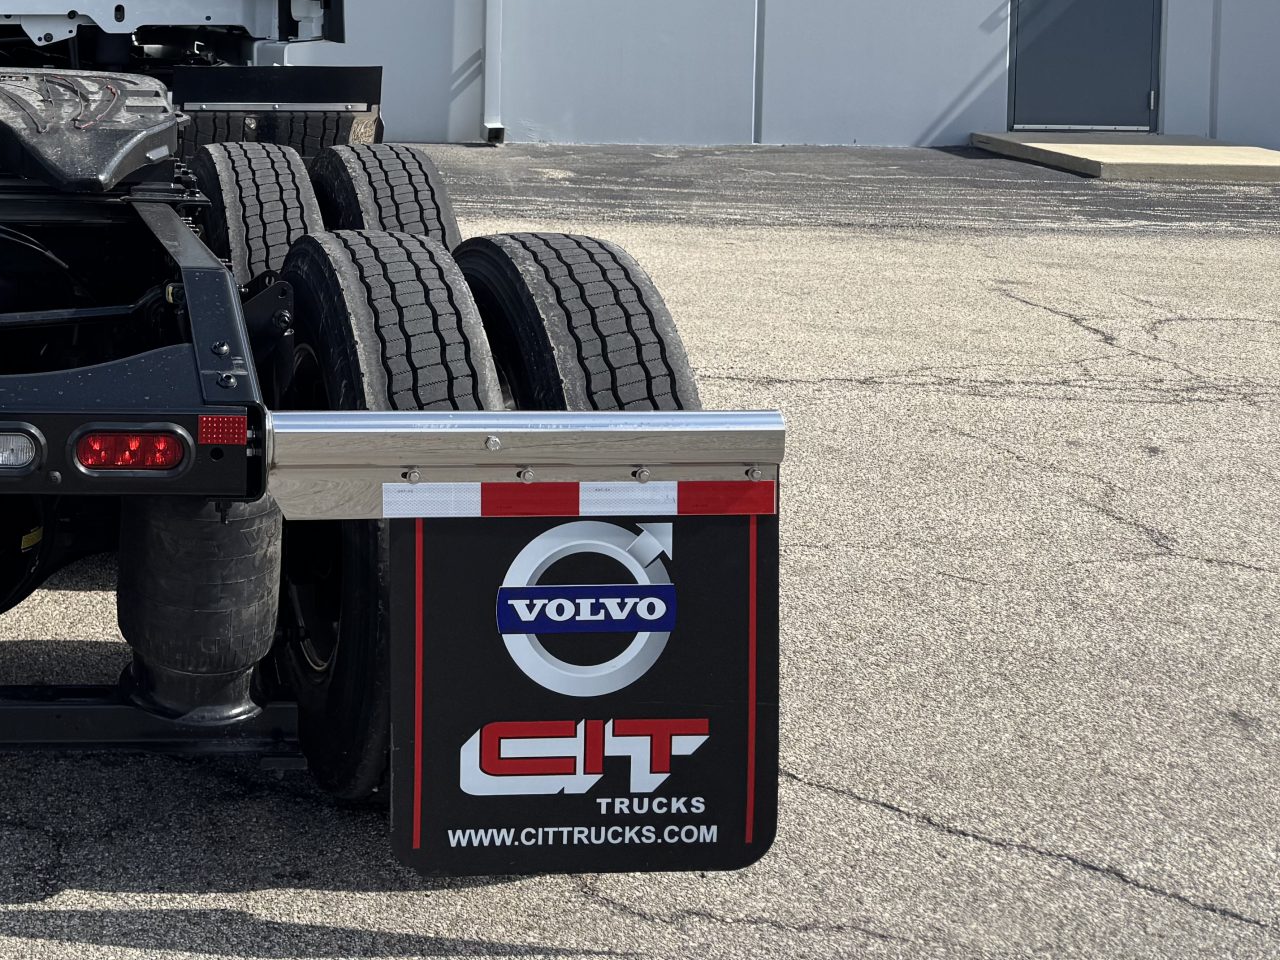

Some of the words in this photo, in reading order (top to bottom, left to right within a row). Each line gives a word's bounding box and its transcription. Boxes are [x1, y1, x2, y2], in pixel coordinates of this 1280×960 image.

[508, 597, 667, 621] VOLVO
[460, 719, 710, 795] CIT
[597, 797, 706, 814] TRUCKS
[447, 824, 718, 847] WWW.CITTRUCKS.COM
